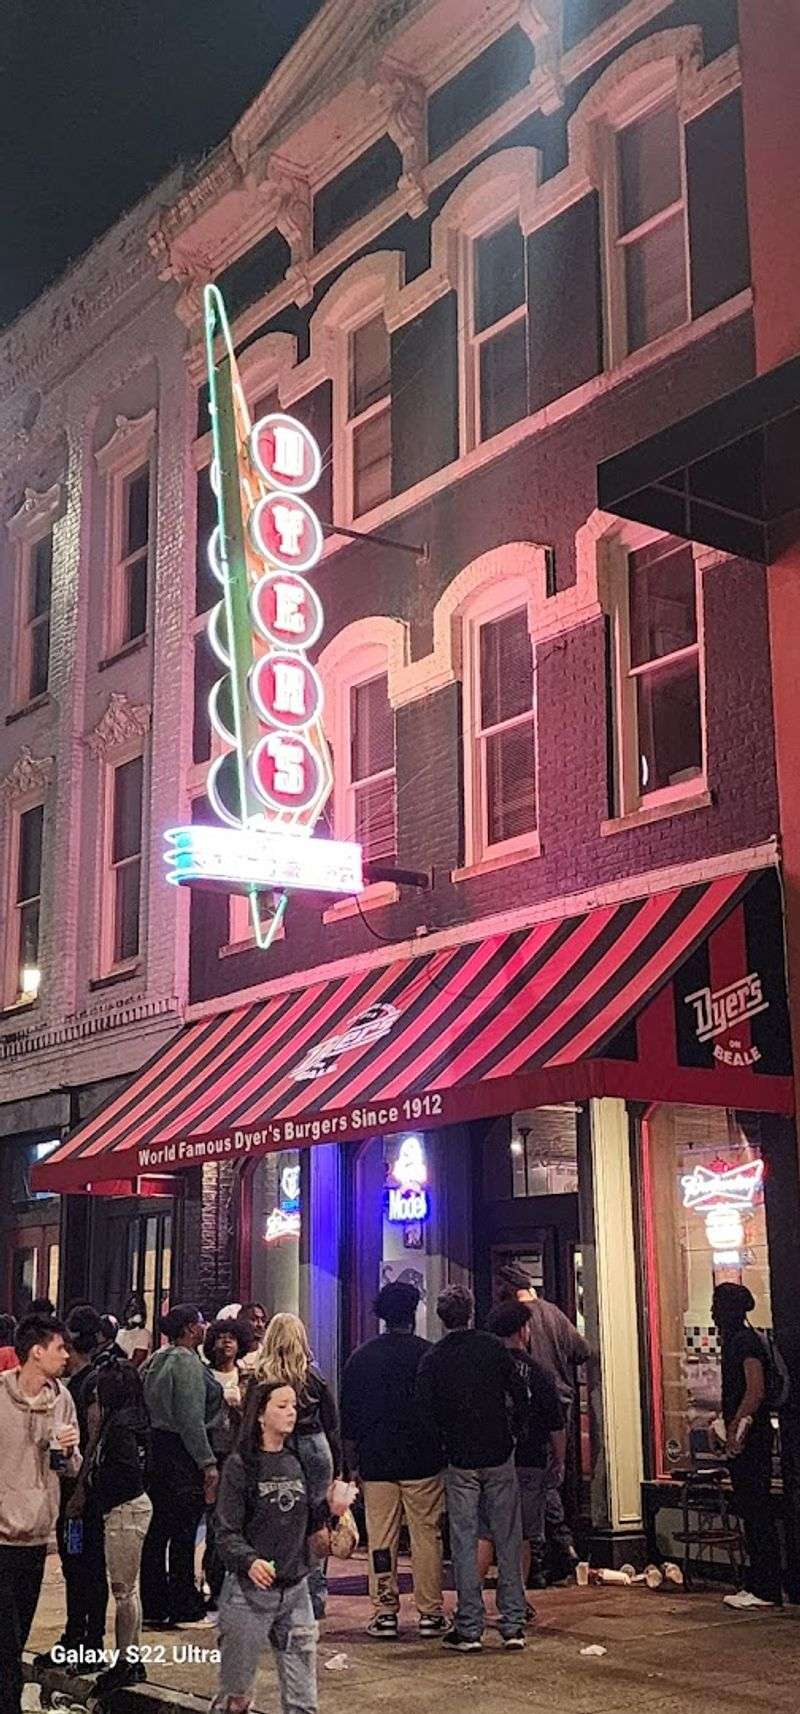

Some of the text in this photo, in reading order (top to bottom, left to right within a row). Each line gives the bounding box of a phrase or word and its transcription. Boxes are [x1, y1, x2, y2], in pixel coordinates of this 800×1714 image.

[712, 1044, 762, 1066] BEALE
[138, 1094, 442, 1167] World Famous Dyer's Burgers Since 1912
